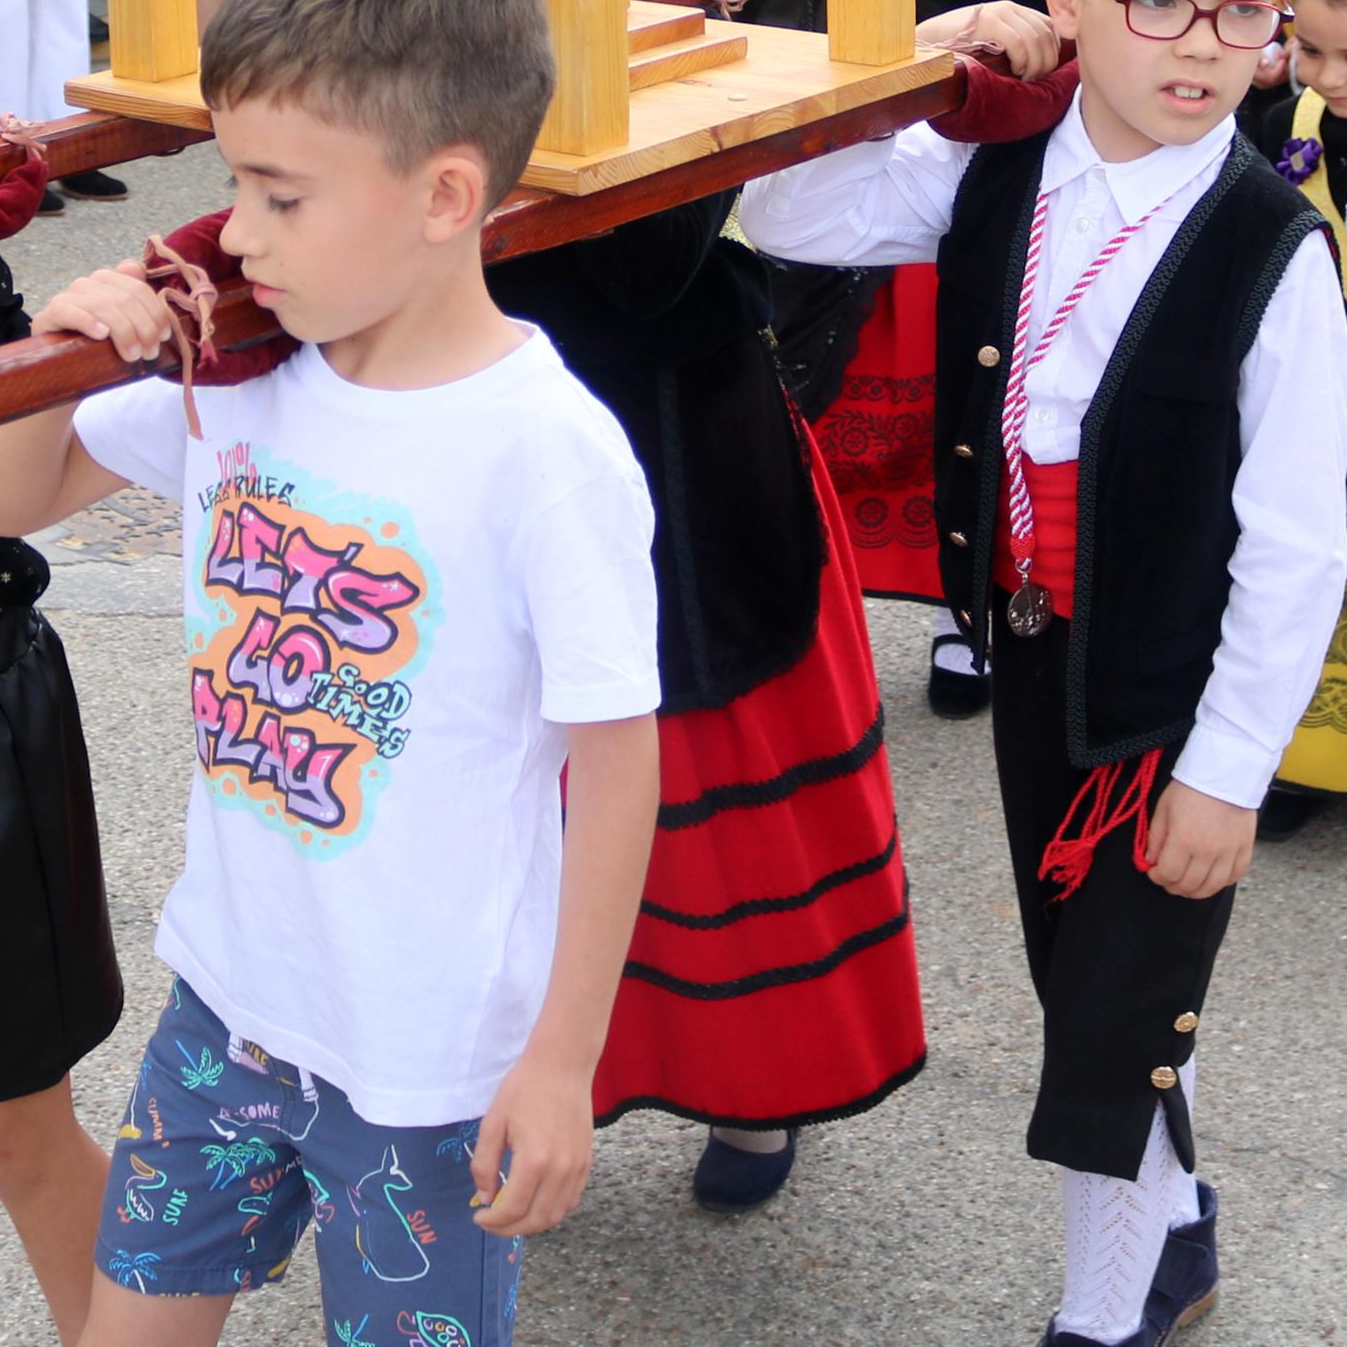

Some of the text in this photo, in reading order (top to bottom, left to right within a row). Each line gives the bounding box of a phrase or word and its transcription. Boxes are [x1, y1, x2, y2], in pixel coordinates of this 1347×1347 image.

[234, 474, 295, 507] RULES
[205, 502, 420, 654] LET'S
[226, 608, 330, 714] GO
[191, 667, 357, 830] PLAY
[305, 670, 412, 759] TIMES
[162, 1188, 189, 1227] SURF
[407, 1209, 437, 1245] SUN
